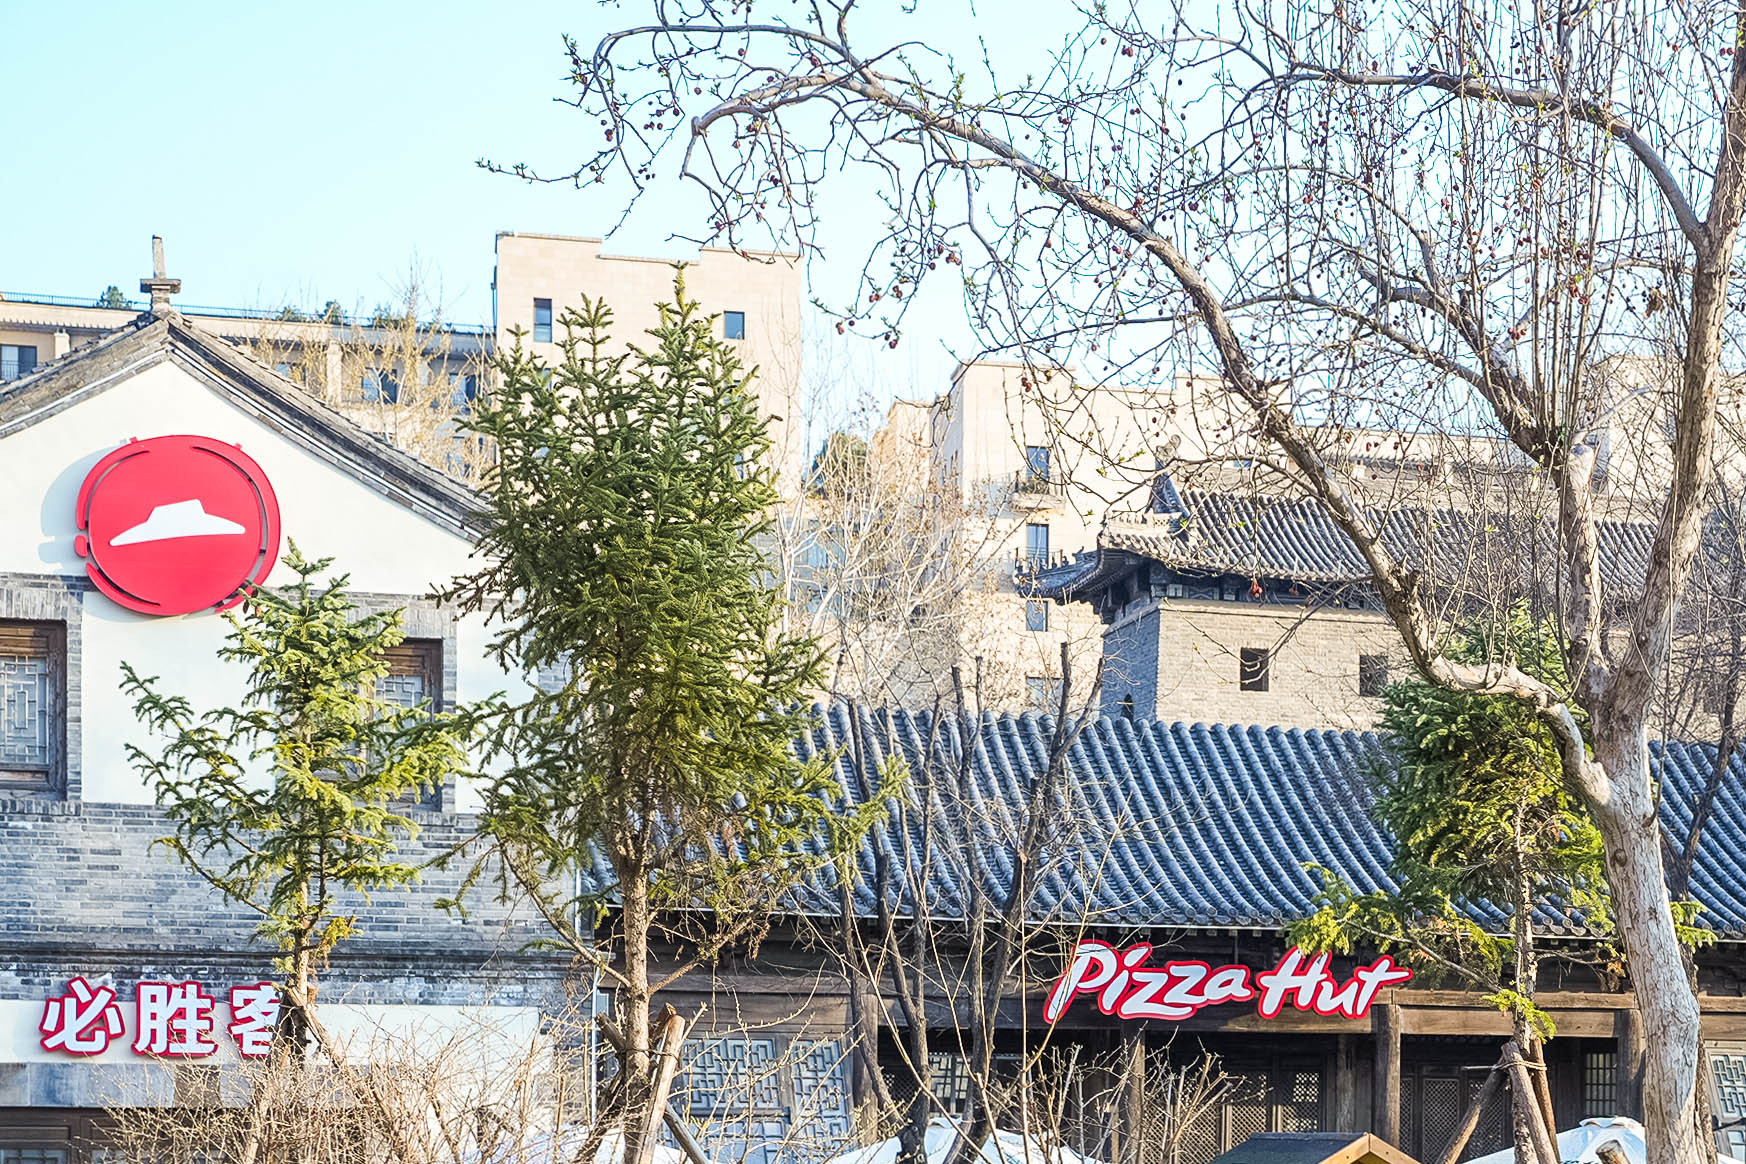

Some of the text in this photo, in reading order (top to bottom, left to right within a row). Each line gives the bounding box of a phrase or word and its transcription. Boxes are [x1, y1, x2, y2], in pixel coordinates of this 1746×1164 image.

[39, 976, 283, 1057] 必胜客
[1044, 940, 1413, 1023] Pizza Hut
